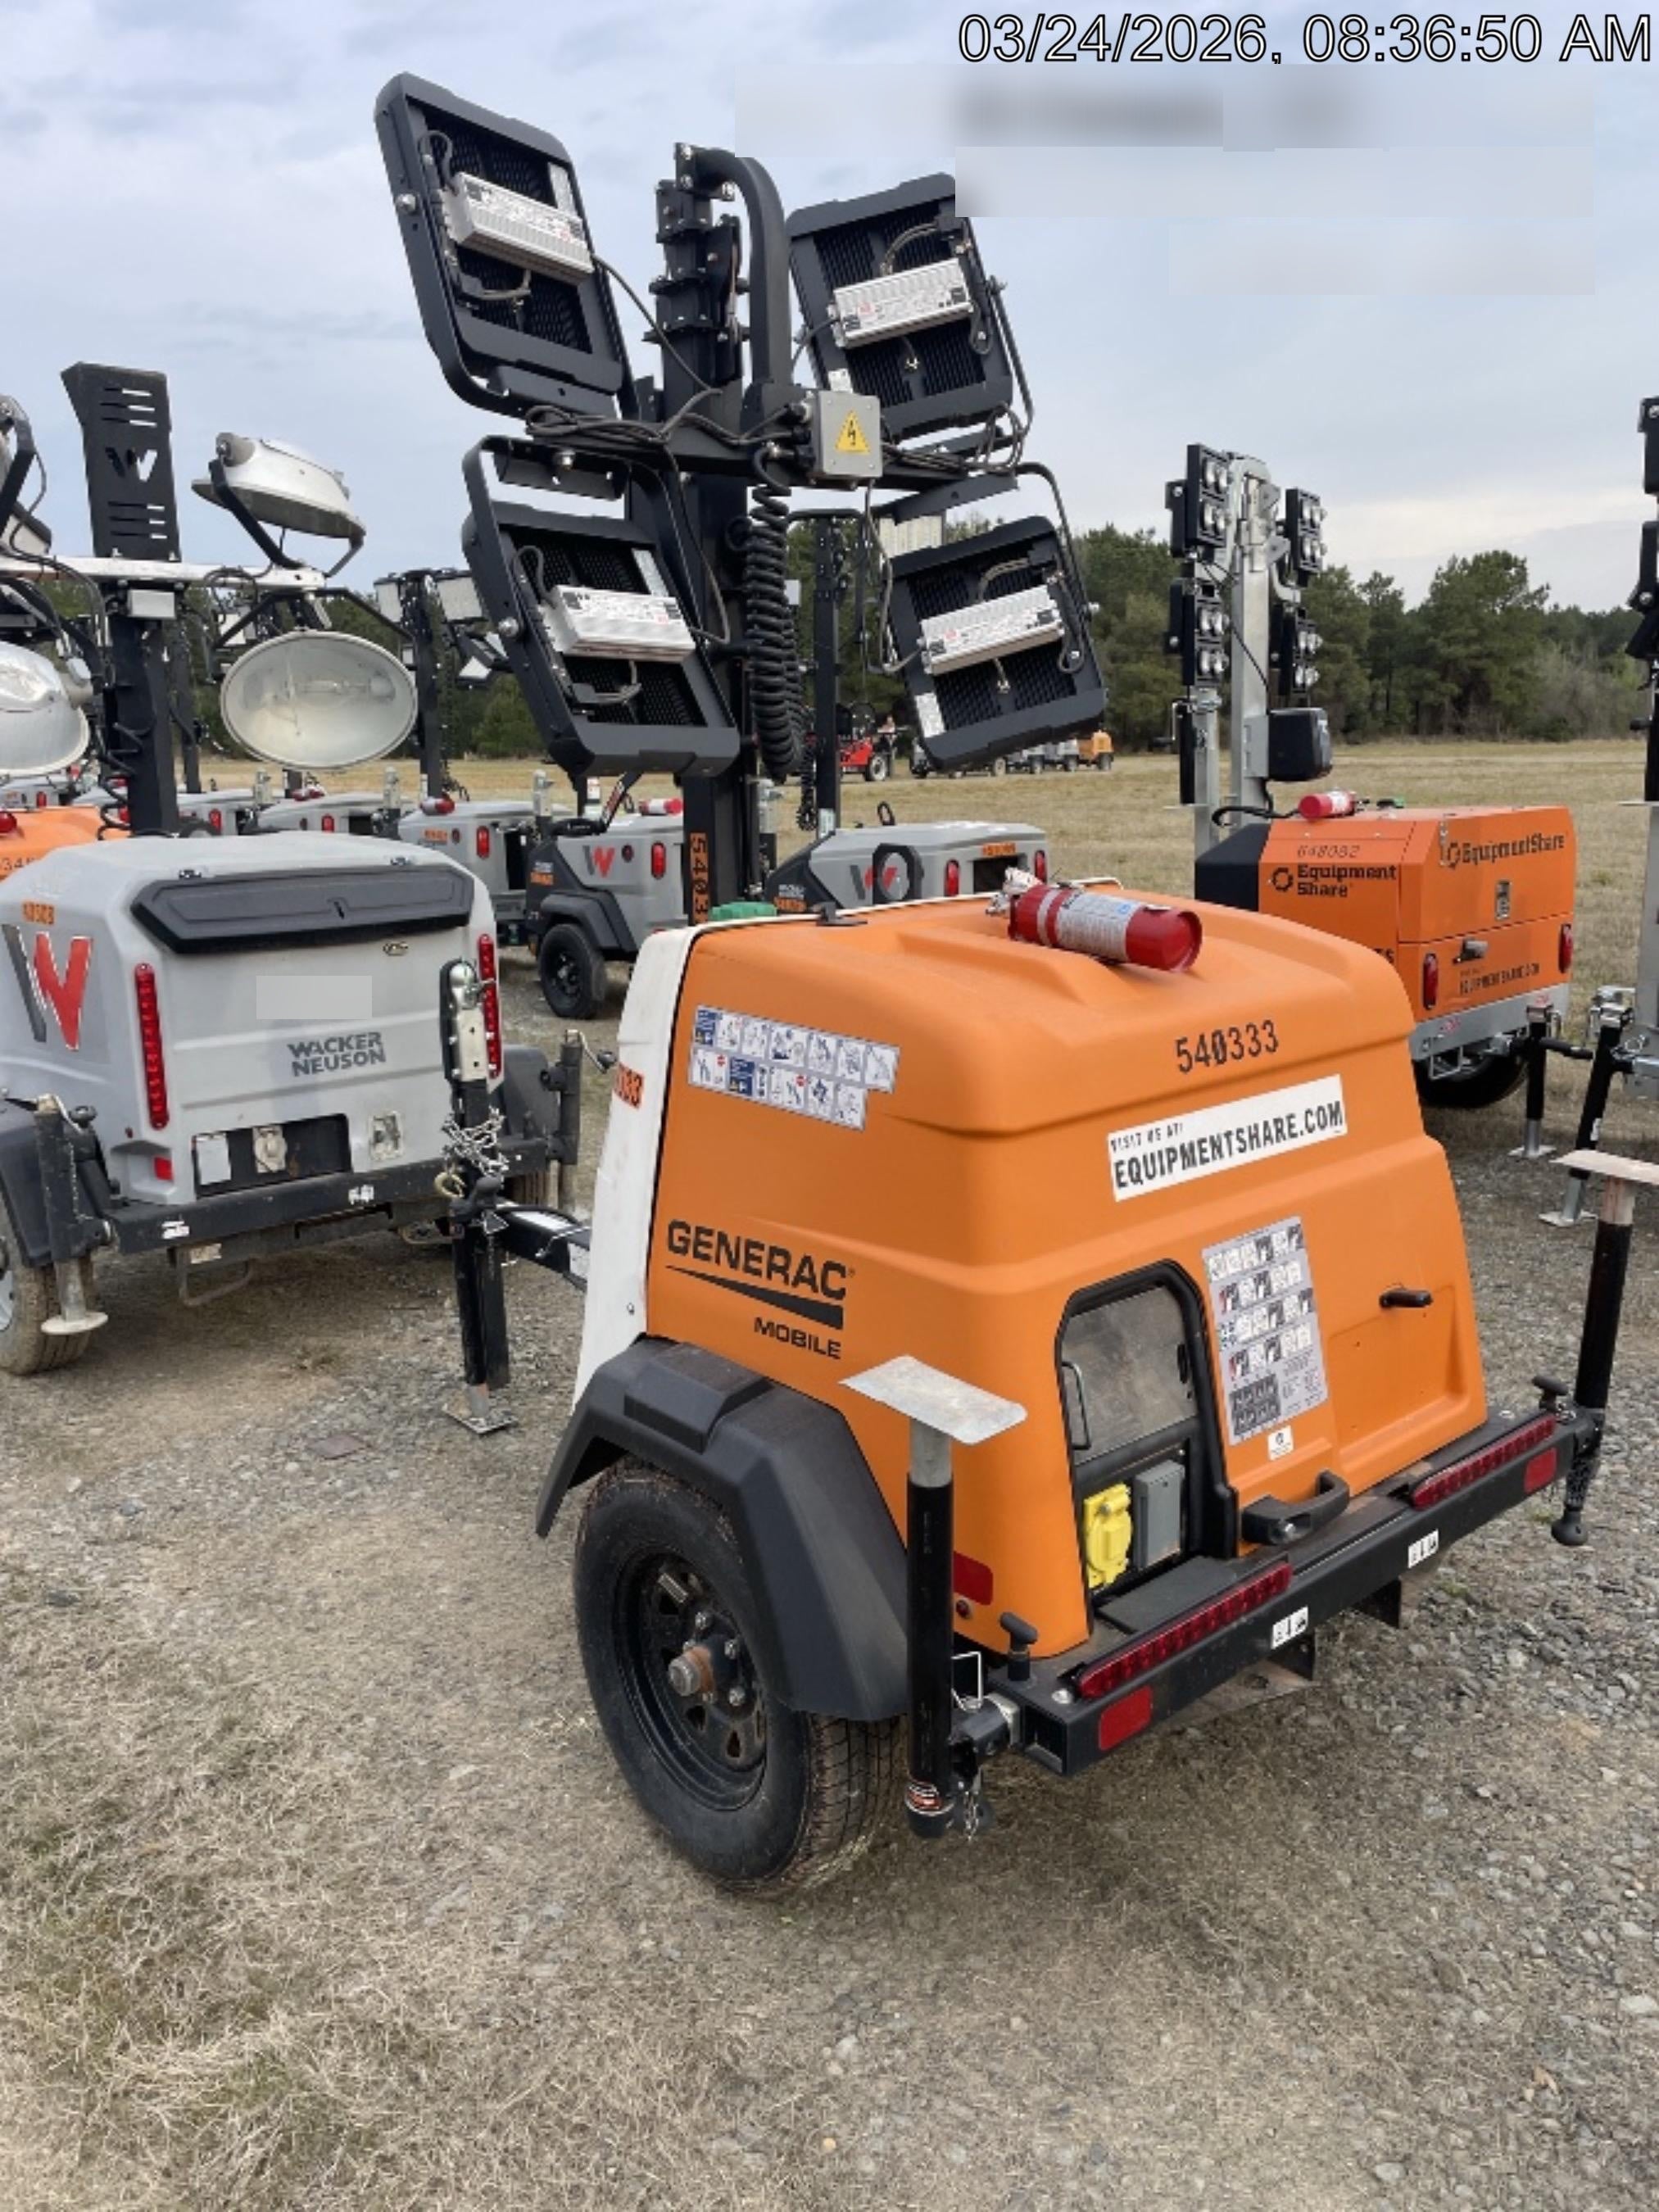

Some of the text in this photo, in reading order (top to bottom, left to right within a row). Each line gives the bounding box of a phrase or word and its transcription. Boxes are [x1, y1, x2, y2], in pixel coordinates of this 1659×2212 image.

[1462, 832, 1564, 866] EquipmentShare
[691, 836, 709, 924] 5403
[1297, 864, 1396, 882] Equipment
[1297, 882, 1348, 898] Share
[287, 1031, 383, 1058] WACKER
[292, 1044, 386, 1077] NEUSON
[1174, 1019, 1279, 1074] 540333
[1110, 1132, 1141, 1153] VISIT
[1113, 1100, 1344, 1189] EQUIPMENTSHARE.COM
[668, 1218, 846, 1301] GENERAC
[754, 1316, 842, 1360] MOBILE
